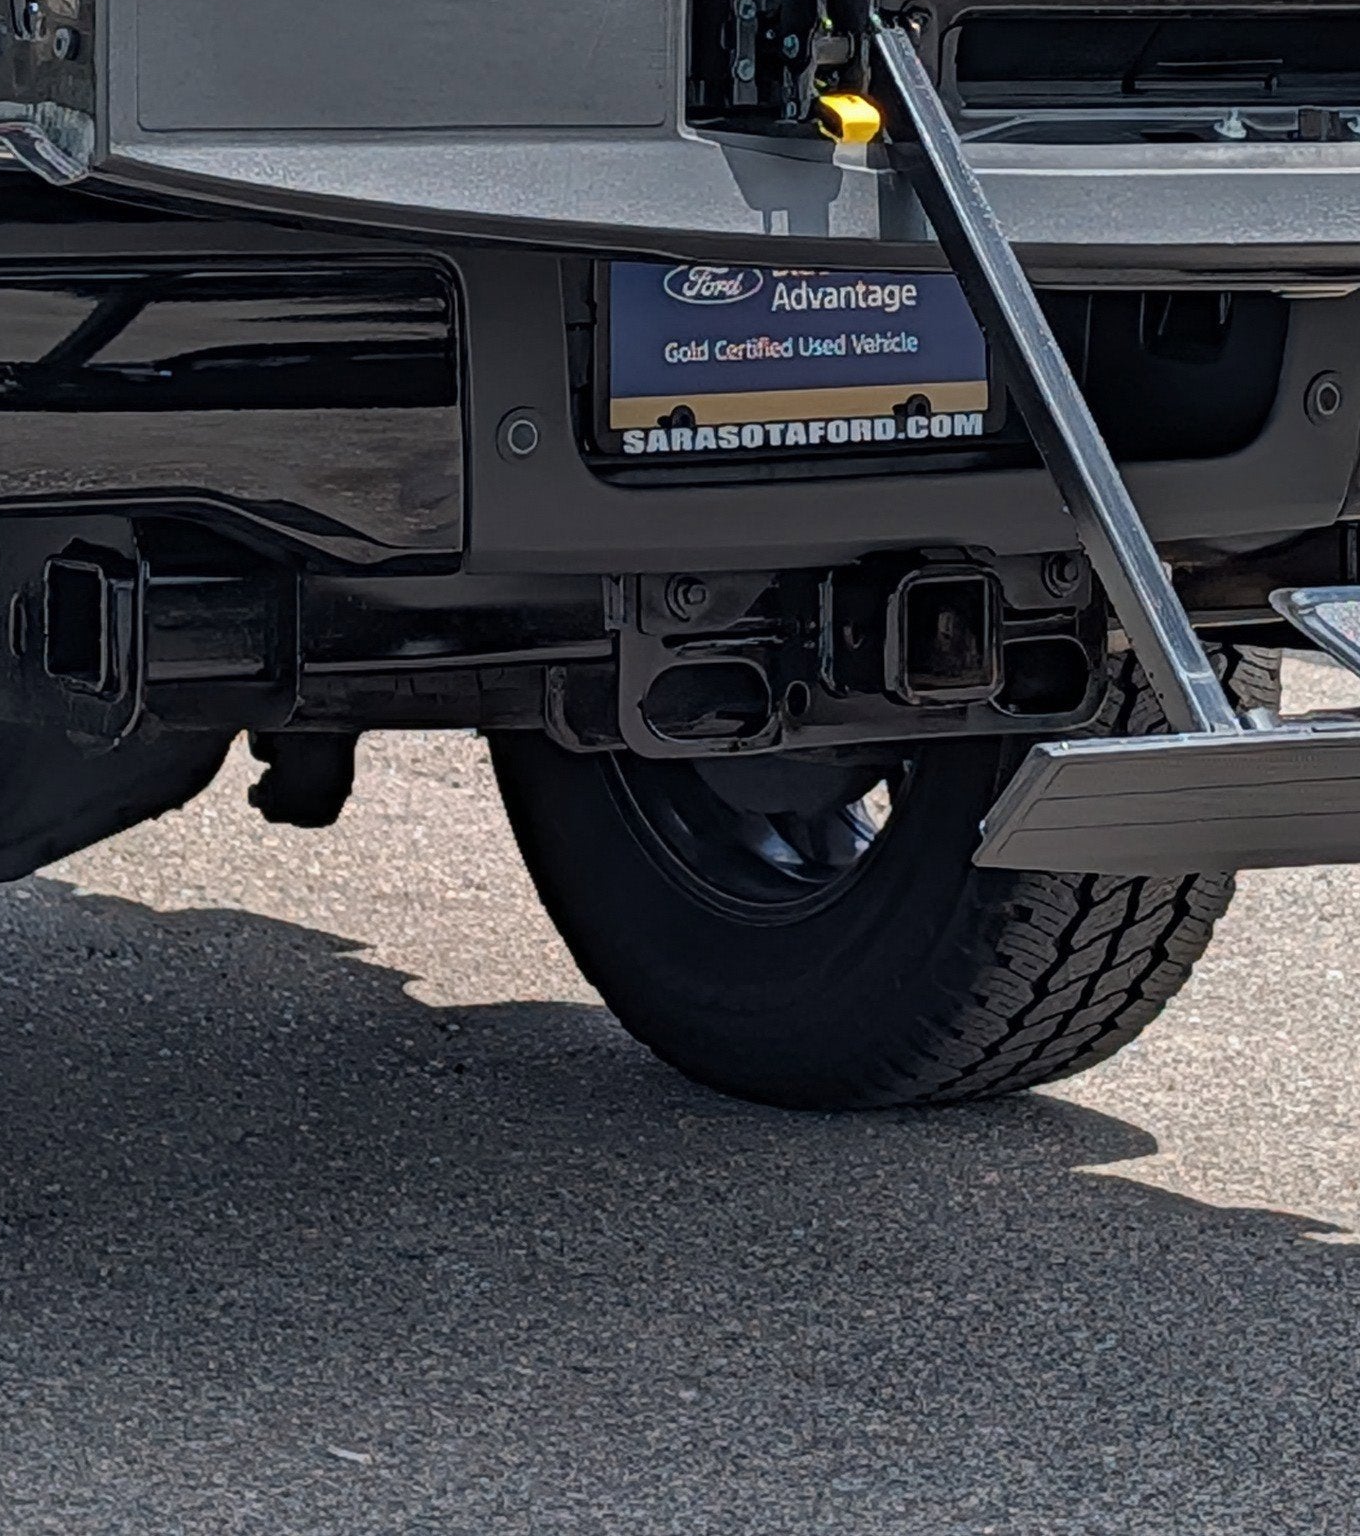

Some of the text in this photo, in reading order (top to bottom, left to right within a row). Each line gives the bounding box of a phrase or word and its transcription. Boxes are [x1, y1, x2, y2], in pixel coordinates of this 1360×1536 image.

[682, 266, 745, 296] Ford
[771, 280, 918, 313] Advantage
[664, 331, 919, 364] Gold Certified Used Vehicle
[622, 413, 984, 455] SARASOTAFORD.COM
